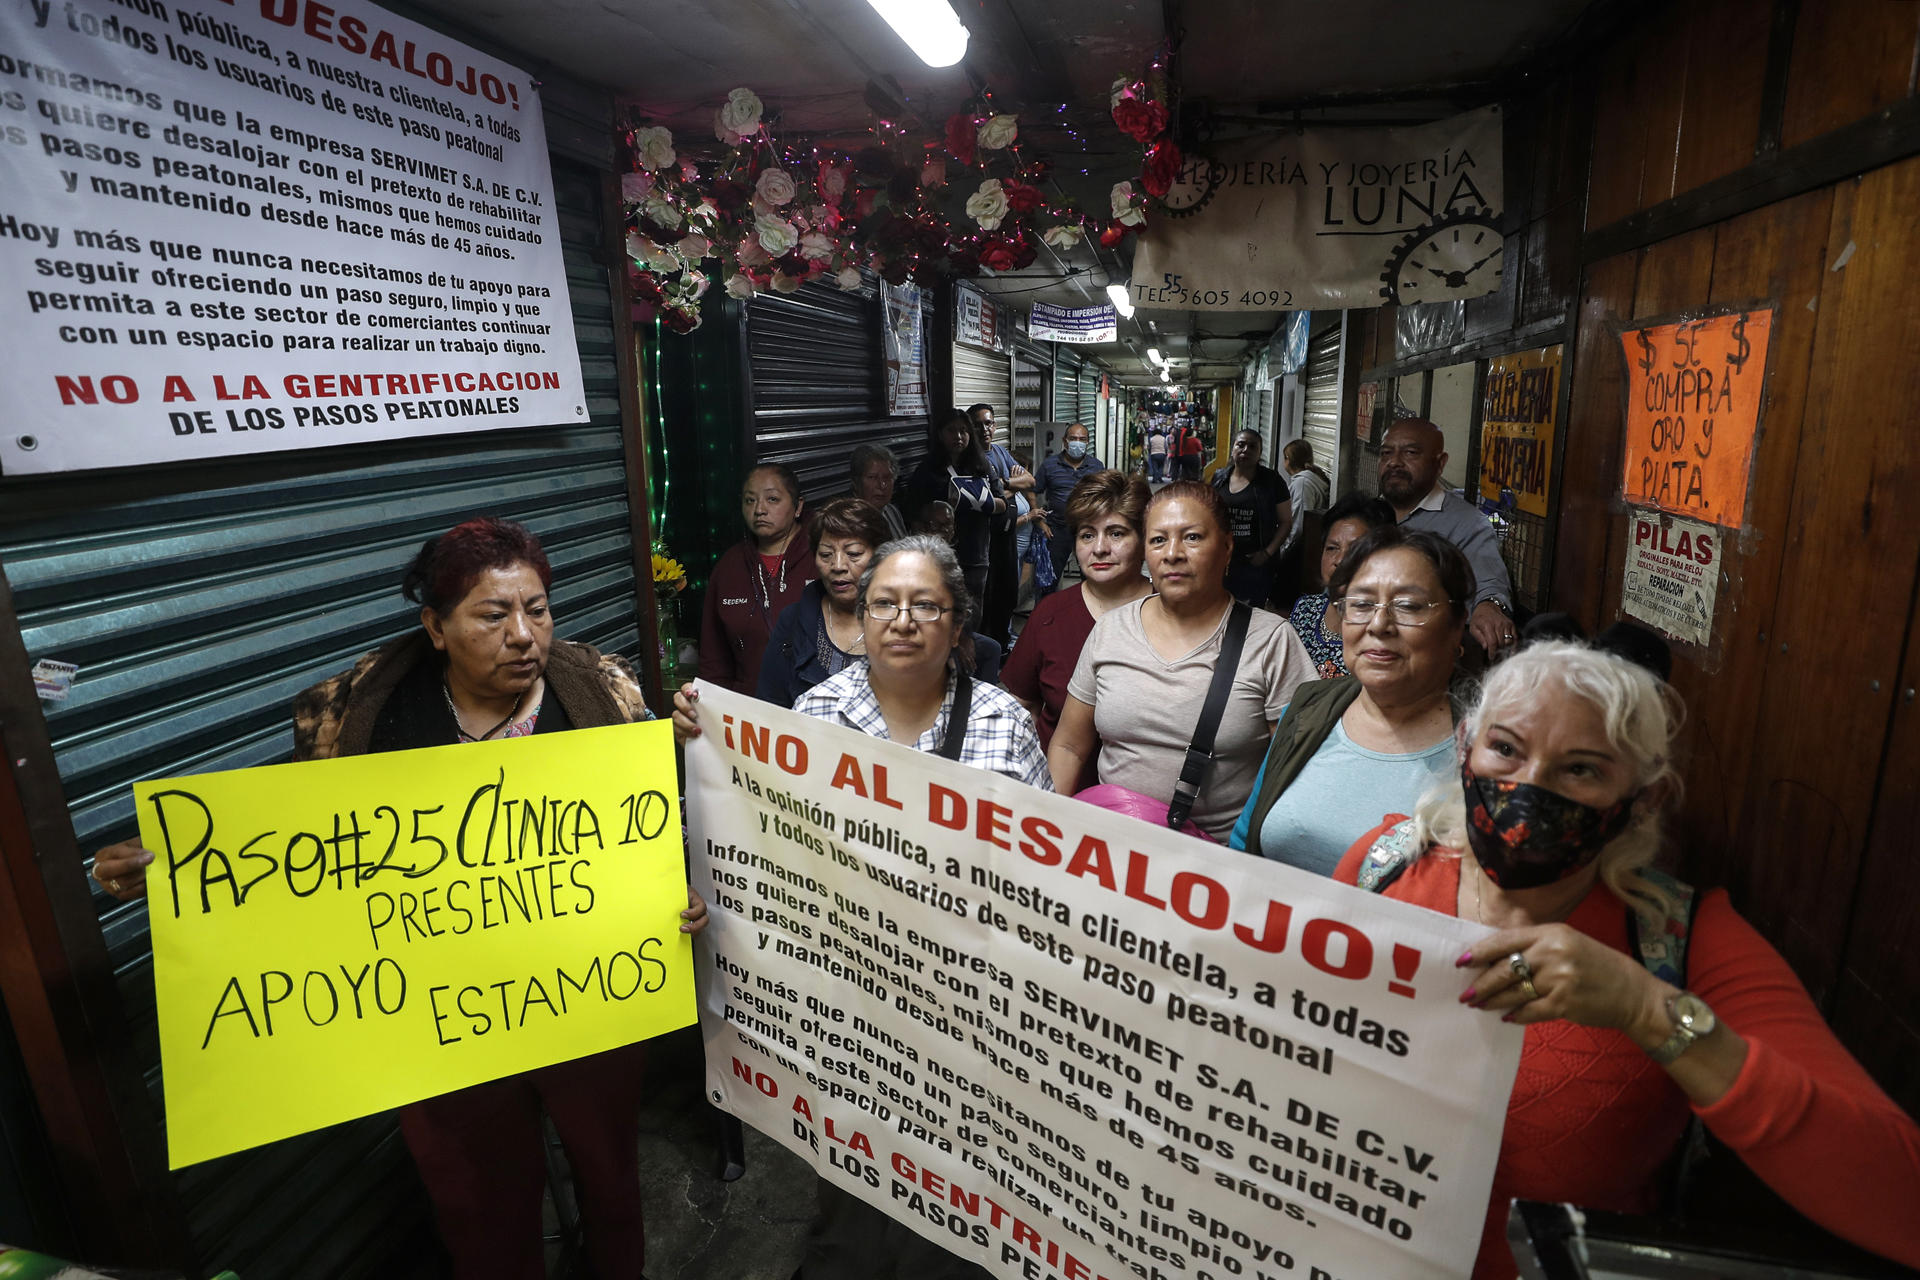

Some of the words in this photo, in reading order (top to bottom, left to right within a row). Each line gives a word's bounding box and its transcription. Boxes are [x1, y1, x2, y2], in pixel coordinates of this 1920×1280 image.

[1319, 161, 1340, 185] Y
[1347, 147, 1476, 187] JOYERÍA
[1323, 170, 1487, 226] LUNA
[0, 214, 59, 248] Hoy
[74, 229, 141, 253] más
[149, 240, 202, 262] que
[212, 248, 293, 270] nunca
[301, 258, 423, 285] necesitamos
[428, 271, 446, 287] de
[450, 274, 464, 290] tu
[469, 280, 512, 296] apoyo
[517, 285, 551, 298] para
[1163, 272, 1183, 294] 55
[27, 291, 155, 315] permita
[165, 301, 182, 316] a
[190, 301, 245, 320] este
[254, 307, 328, 324] sector
[336, 309, 361, 326] de
[367, 314, 477, 332] comerciantes
[482, 320, 551, 335] continuar
[35, 258, 139, 284] seguir
[151, 268, 292, 296] ofreciendo
[300, 284, 328, 299] un
[336, 288, 382, 304] paso
[388, 292, 447, 312] seguro,
[452, 295, 498, 315] limpio
[502, 303, 510, 316] y
[515, 304, 540, 318] que
[1033, 302, 1066, 317] ESTAMPADO
[1179, 288, 1230, 305] 5605
[1240, 290, 1293, 306] 4092
[59, 326, 118, 344] con
[128, 329, 167, 345] un
[177, 330, 273, 351] espacio
[283, 335, 335, 353] para
[342, 335, 410, 351] realizar
[415, 340, 435, 352] un
[440, 338, 498, 355] trabajo
[503, 339, 545, 356] digno.
[1673, 321, 1707, 369] SE
[1726, 312, 1750, 375] $
[55, 375, 139, 405] NO
[163, 375, 196, 402] A
[213, 375, 271, 400] LA
[283, 372, 560, 399] GENTRIFICACION
[168, 411, 217, 436] DE
[226, 407, 285, 432] LOS
[293, 403, 378, 427] PASOS
[384, 396, 519, 421] PEATONALES
[1645, 365, 1733, 414] COMPRA
[1651, 415, 1686, 454] ORO
[1635, 520, 1713, 565] PILAS
[1639, 550, 1669, 566] ORIGINALES
[1669, 558, 1684, 570] PARA
[1684, 563, 1703, 576] RELOJ
[722, 598, 748, 606] SEDEMA
[1672, 599, 1695, 613] RELOJES
[457, 764, 603, 868] CLINICA
[618, 789, 670, 846] 10
[723, 714, 808, 776] ¡NO
[830, 753, 903, 810] AL
[928, 782, 1421, 999] DESALOJO!
[365, 859, 595, 950] PRESENTES
[732, 765, 743, 787] A
[745, 772, 762, 797] la
[766, 788, 835, 832] opinión
[843, 818, 935, 874] pública,
[945, 857, 960, 879] a
[971, 866, 1070, 927] nuestra
[1082, 914, 1238, 999] clientela,
[1254, 982, 1276, 1008] a
[1292, 989, 1410, 1057] todas
[759, 812, 768, 833] y
[774, 815, 824, 856] todos
[829, 841, 860, 872] los
[865, 863, 968, 918] usuarios
[978, 901, 1008, 932] de
[1017, 924, 1074, 965] este
[1083, 954, 1155, 1004] paso
[1167, 993, 1333, 1075] peatonal
[202, 957, 407, 1050] APOYO
[430, 936, 667, 1046] ESTAMOS
[707, 839, 828, 897] Informamos
[834, 892, 869, 921] que
[878, 911, 898, 936] la
[907, 929, 1013, 991] empresa
[1024, 980, 1184, 1073] SERVIMET
[1196, 1064, 1269, 1111] S.A.
[1287, 1098, 1339, 1140] DE
[1356, 1130, 1438, 1181] C.V.
[712, 868, 747, 890] nos
[756, 881, 820, 918] quiere
[828, 911, 924, 974] desalojar
[933, 969, 979, 1000] con
[989, 994, 1009, 1017] el
[1020, 1011, 1142, 1084] pretexto
[1155, 1080, 1193, 1112] de
[1208, 1105, 1426, 1209] rehabilitar
[715, 888, 744, 913] los
[752, 905, 812, 939] pasos
[820, 932, 944, 1012] peatonales,
[953, 1004, 1049, 1066] mismos
[1059, 1061, 1113, 1099] que
[1125, 1090, 1234, 1159] hemos
[1248, 1155, 1412, 1241] cuidado
[758, 932, 769, 950] y
[776, 939, 887, 1002] mantenido
[895, 996, 964, 1042] desde
[972, 1034, 1029, 1084] hace
[1040, 1079, 1098, 1121] más
[1109, 1118, 1144, 1149] de
[1157, 1144, 1200, 1175] 45
[1214, 1172, 1316, 1228] años.
[731, 1056, 778, 1098] NO
[792, 1094, 813, 1124] A
[824, 1117, 875, 1160] LA
[891, 1152, 1109, 1280] GENTRIF
[793, 1118, 819, 1155] DE
[829, 1146, 880, 1188] LOS
[892, 1179, 989, 1248] PASOS
